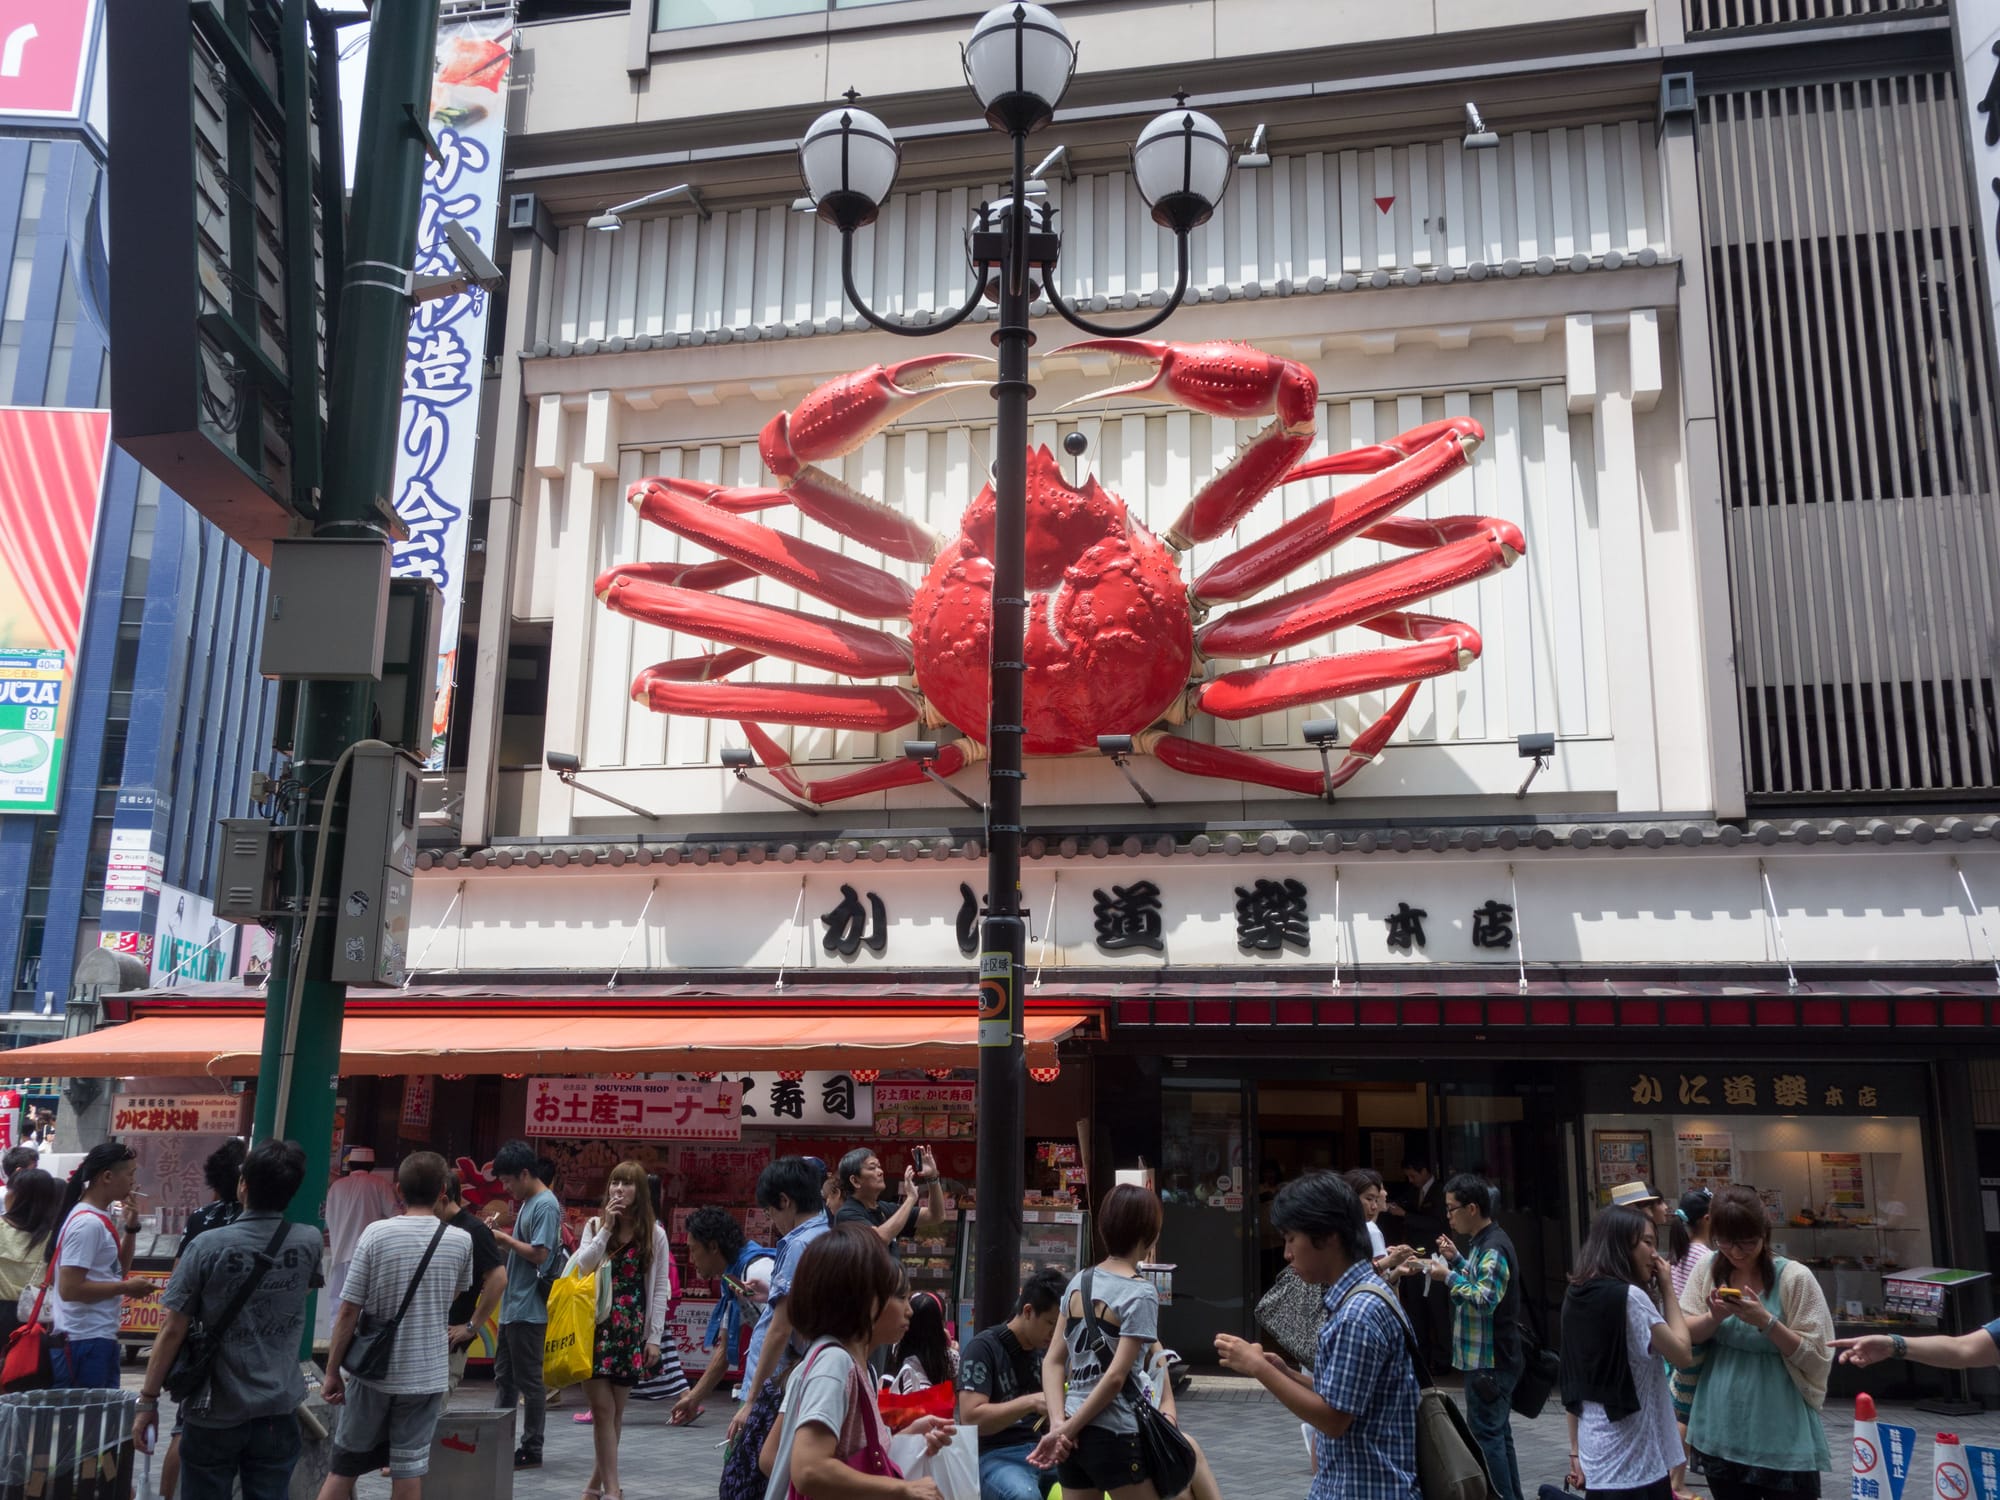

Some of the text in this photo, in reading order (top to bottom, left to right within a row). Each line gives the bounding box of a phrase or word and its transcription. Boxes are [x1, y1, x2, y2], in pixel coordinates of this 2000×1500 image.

[1384, 900, 1514, 949] 本店
[158, 934, 227, 982] WEEKDY
[981, 959, 1008, 972] 止区域
[593, 1084, 642, 1093] SOUVENIR
[644, 1085, 669, 1093] SHOP
[1824, 1085, 1878, 1107] 本店
[116, 1109, 199, 1130] かに炭火焼
[533, 1091, 732, 1126] お土産コーナー
